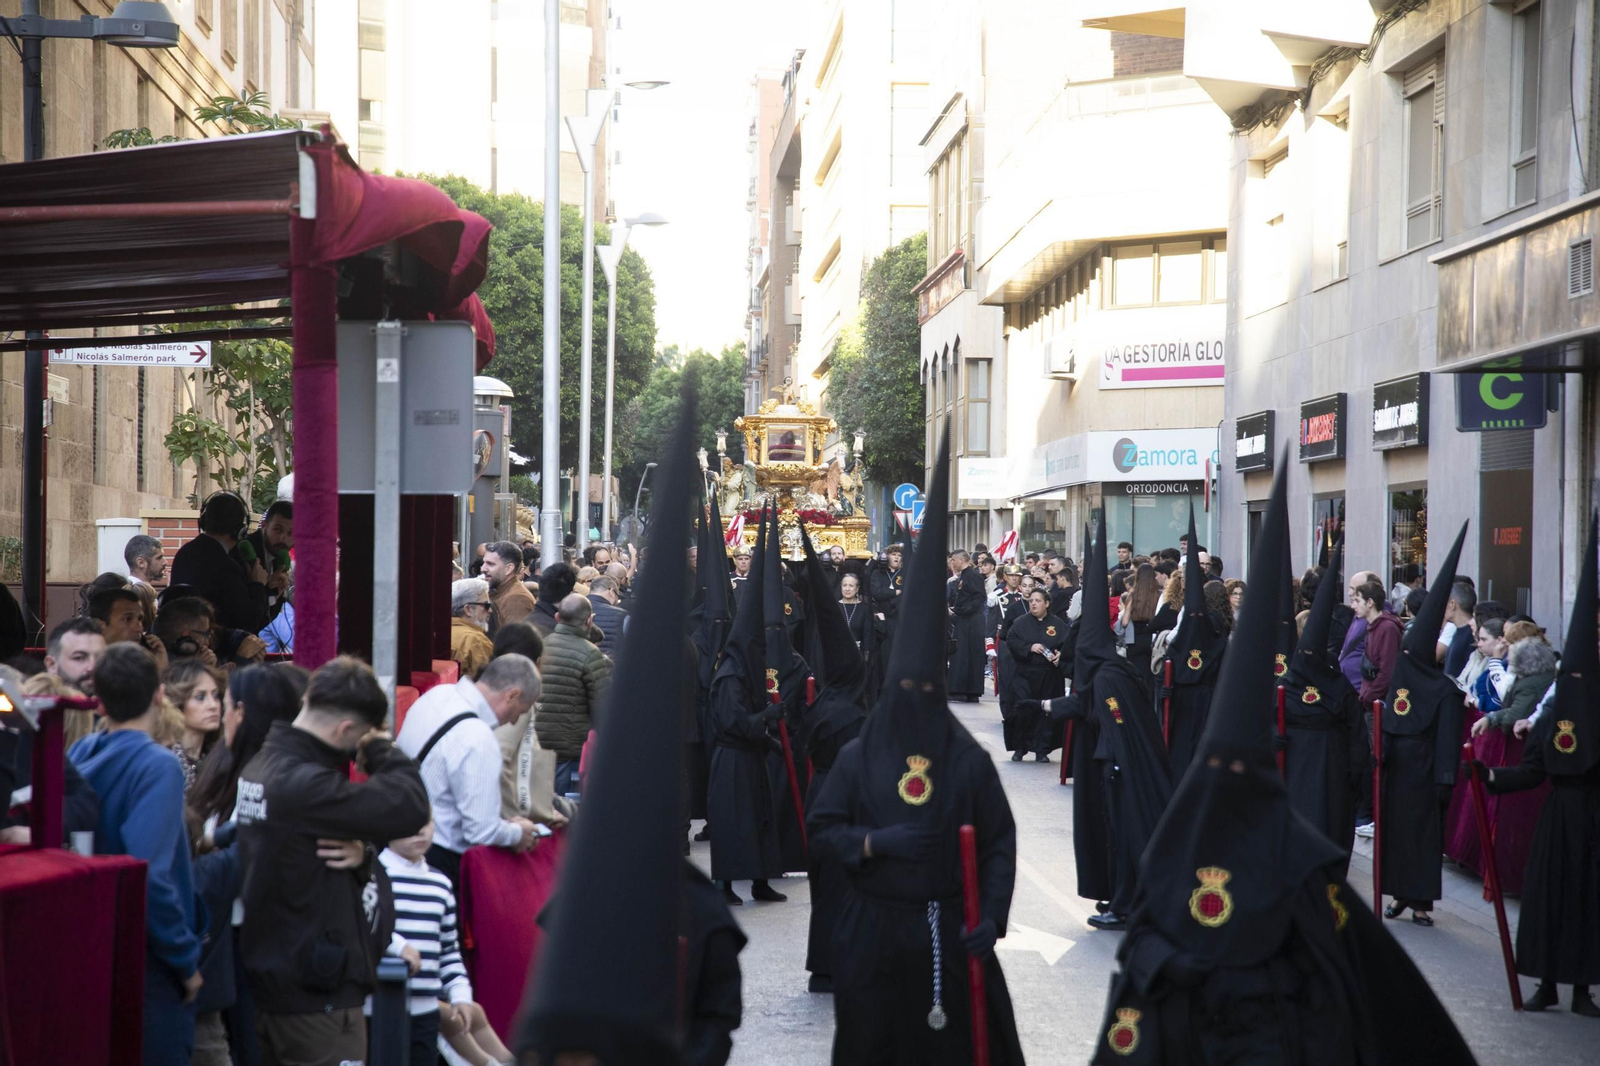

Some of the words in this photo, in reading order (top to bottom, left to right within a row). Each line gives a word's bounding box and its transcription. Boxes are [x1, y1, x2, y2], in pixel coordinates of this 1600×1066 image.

[146, 343, 188, 351] Salmerón
[1124, 338, 1191, 364] GESTORÍA
[76, 352, 109, 361] Nicolás
[111, 353, 154, 362] Salmerón
[156, 354, 176, 363] park
[1122, 444, 1198, 467] Zamora
[1125, 482, 1190, 495] ORTODONCIA
